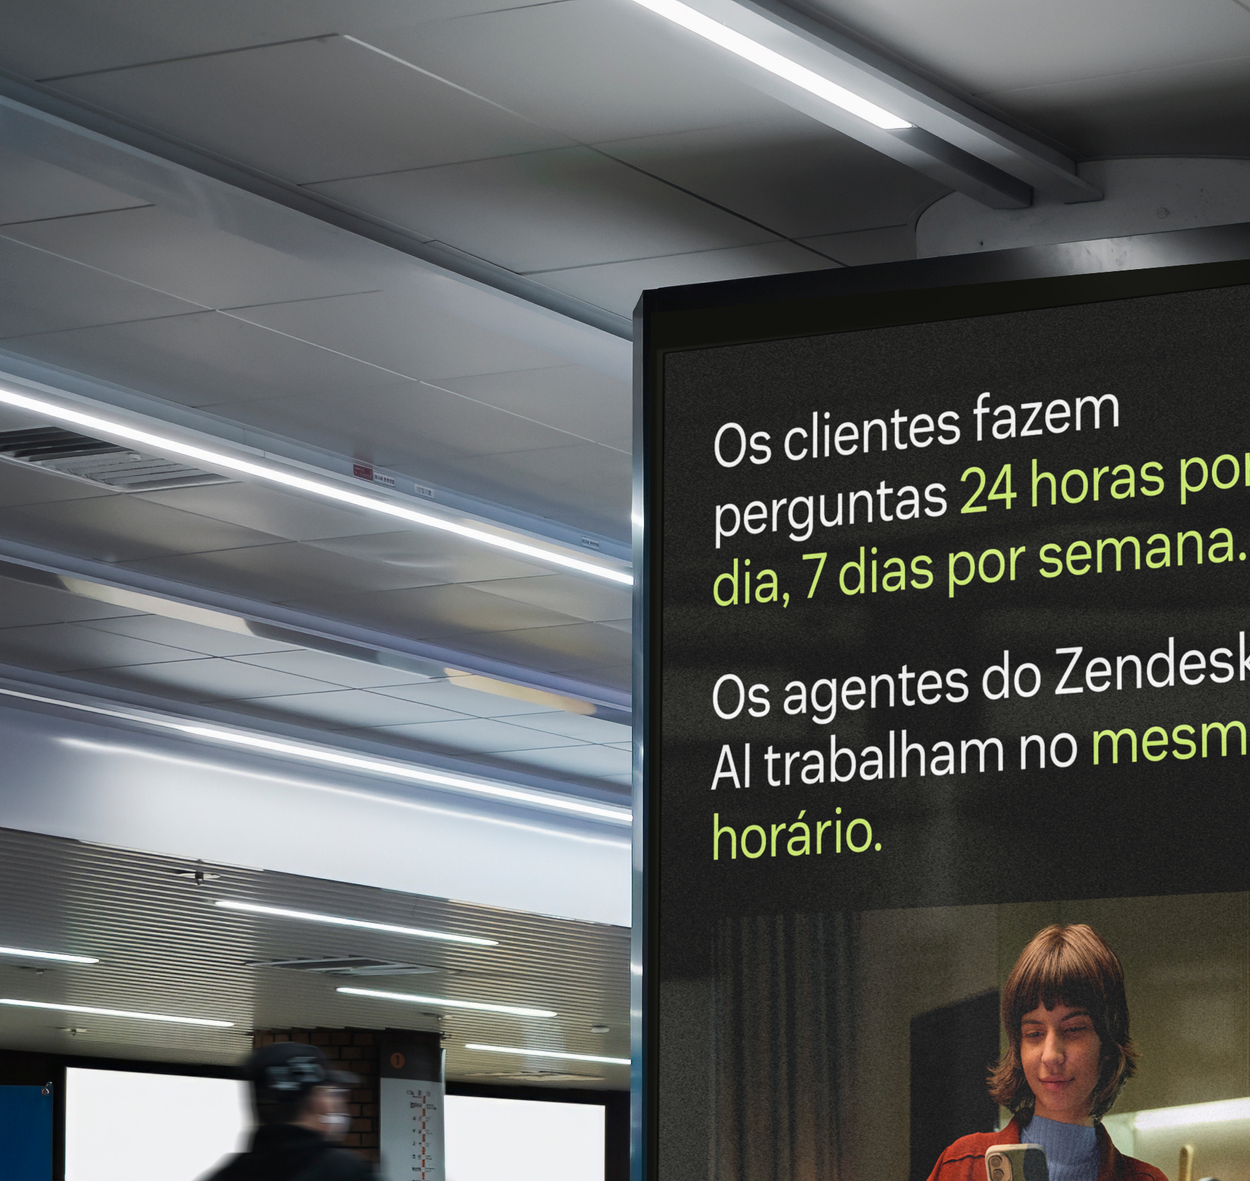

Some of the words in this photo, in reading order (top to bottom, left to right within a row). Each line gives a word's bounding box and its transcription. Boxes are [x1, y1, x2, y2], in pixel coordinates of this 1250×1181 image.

[714, 422, 772, 468] Os
[783, 408, 961, 461] clientes
[972, 391, 1119, 442] fazem
[715, 480, 948, 550] perguntas
[960, 463, 1018, 514] 24
[1031, 458, 1165, 508] horas
[713, 557, 790, 609] dia,
[802, 551, 828, 599] 7
[838, 545, 934, 596] dias
[948, 545, 1026, 599] por
[1038, 527, 1247, 579] semana.
[712, 673, 771, 720] Os
[783, 664, 969, 725] agentes
[981, 649, 1042, 701] do
[710, 742, 751, 791] AI
[763, 729, 1004, 787] trabalham
[1020, 732, 1078, 770] no
[713, 806, 882, 861] horário.
